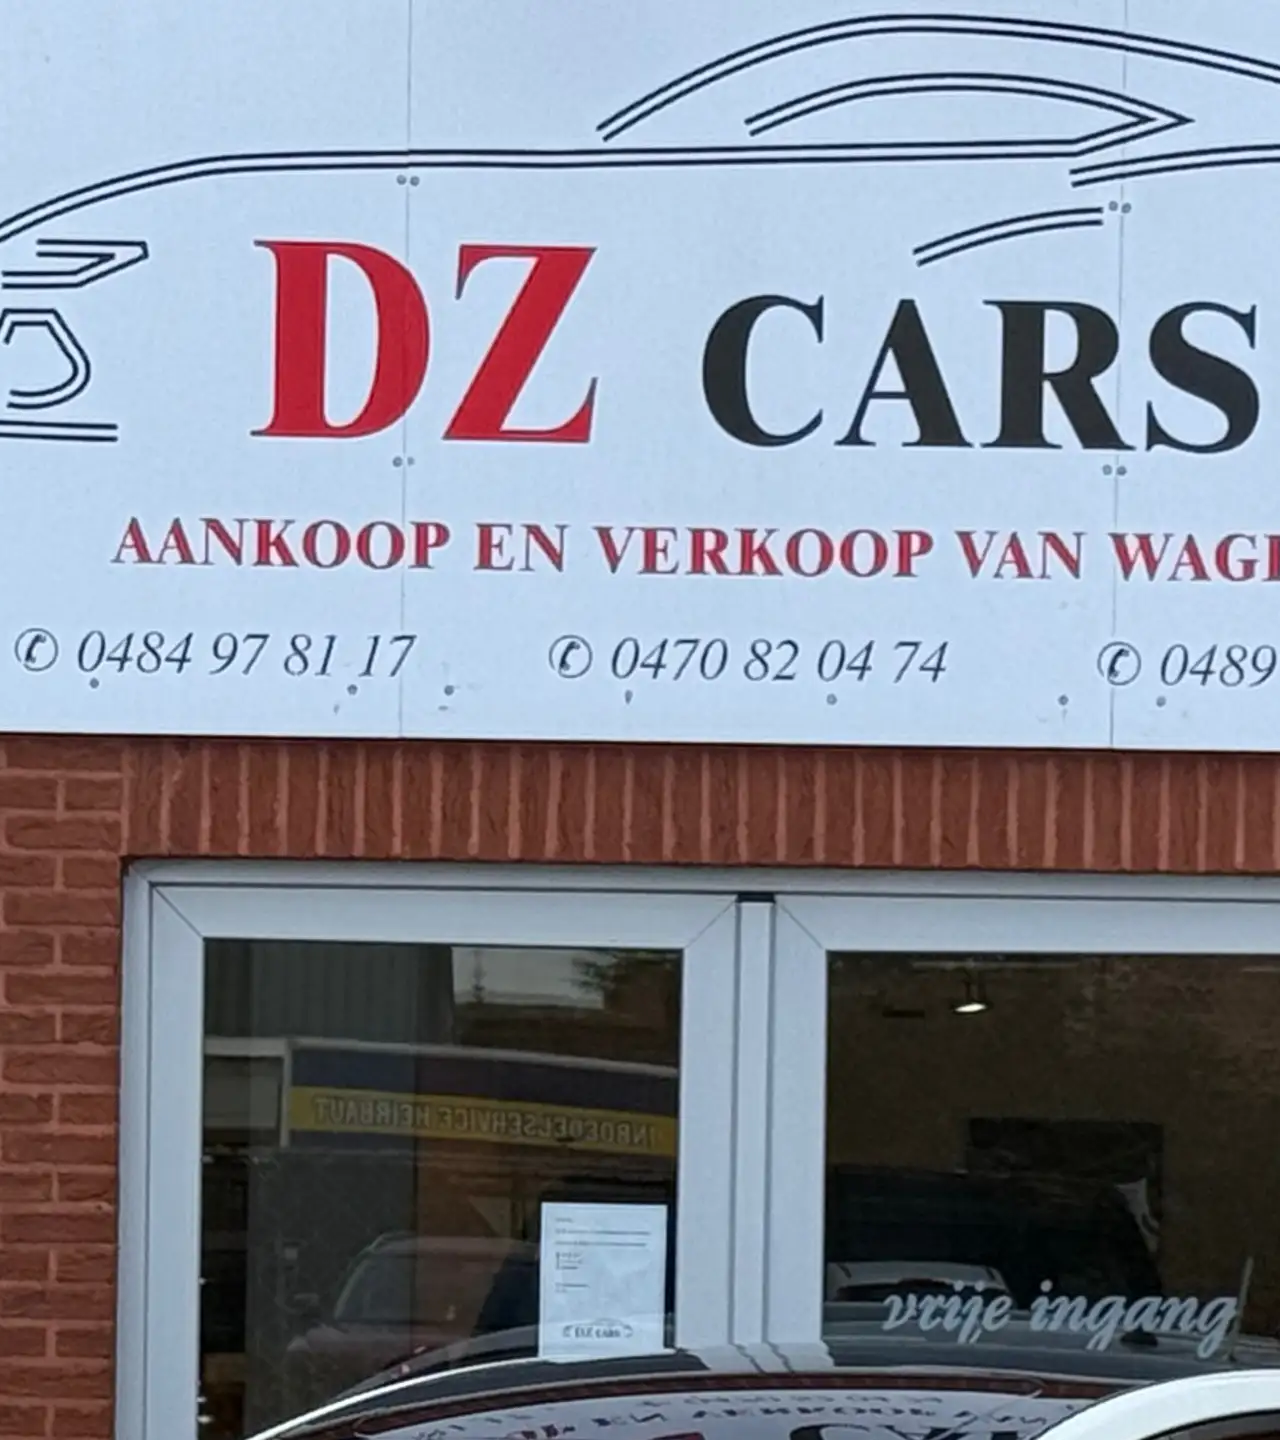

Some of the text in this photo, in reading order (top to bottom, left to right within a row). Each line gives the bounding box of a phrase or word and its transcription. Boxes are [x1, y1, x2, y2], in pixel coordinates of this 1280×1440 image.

[250, 239, 1260, 454] DZ CARS
[111, 517, 450, 569] AANKOOP
[474, 523, 568, 572] EN
[593, 526, 933, 577] VERKOOP
[955, 531, 1085, 579] VAN
[78, 631, 417, 677] 0484 97 81 17
[612, 638, 948, 682] 0470 82 04 74
[1161, 644, 1276, 687] 0489
[882, 1279, 1239, 1358] vrije ingang
